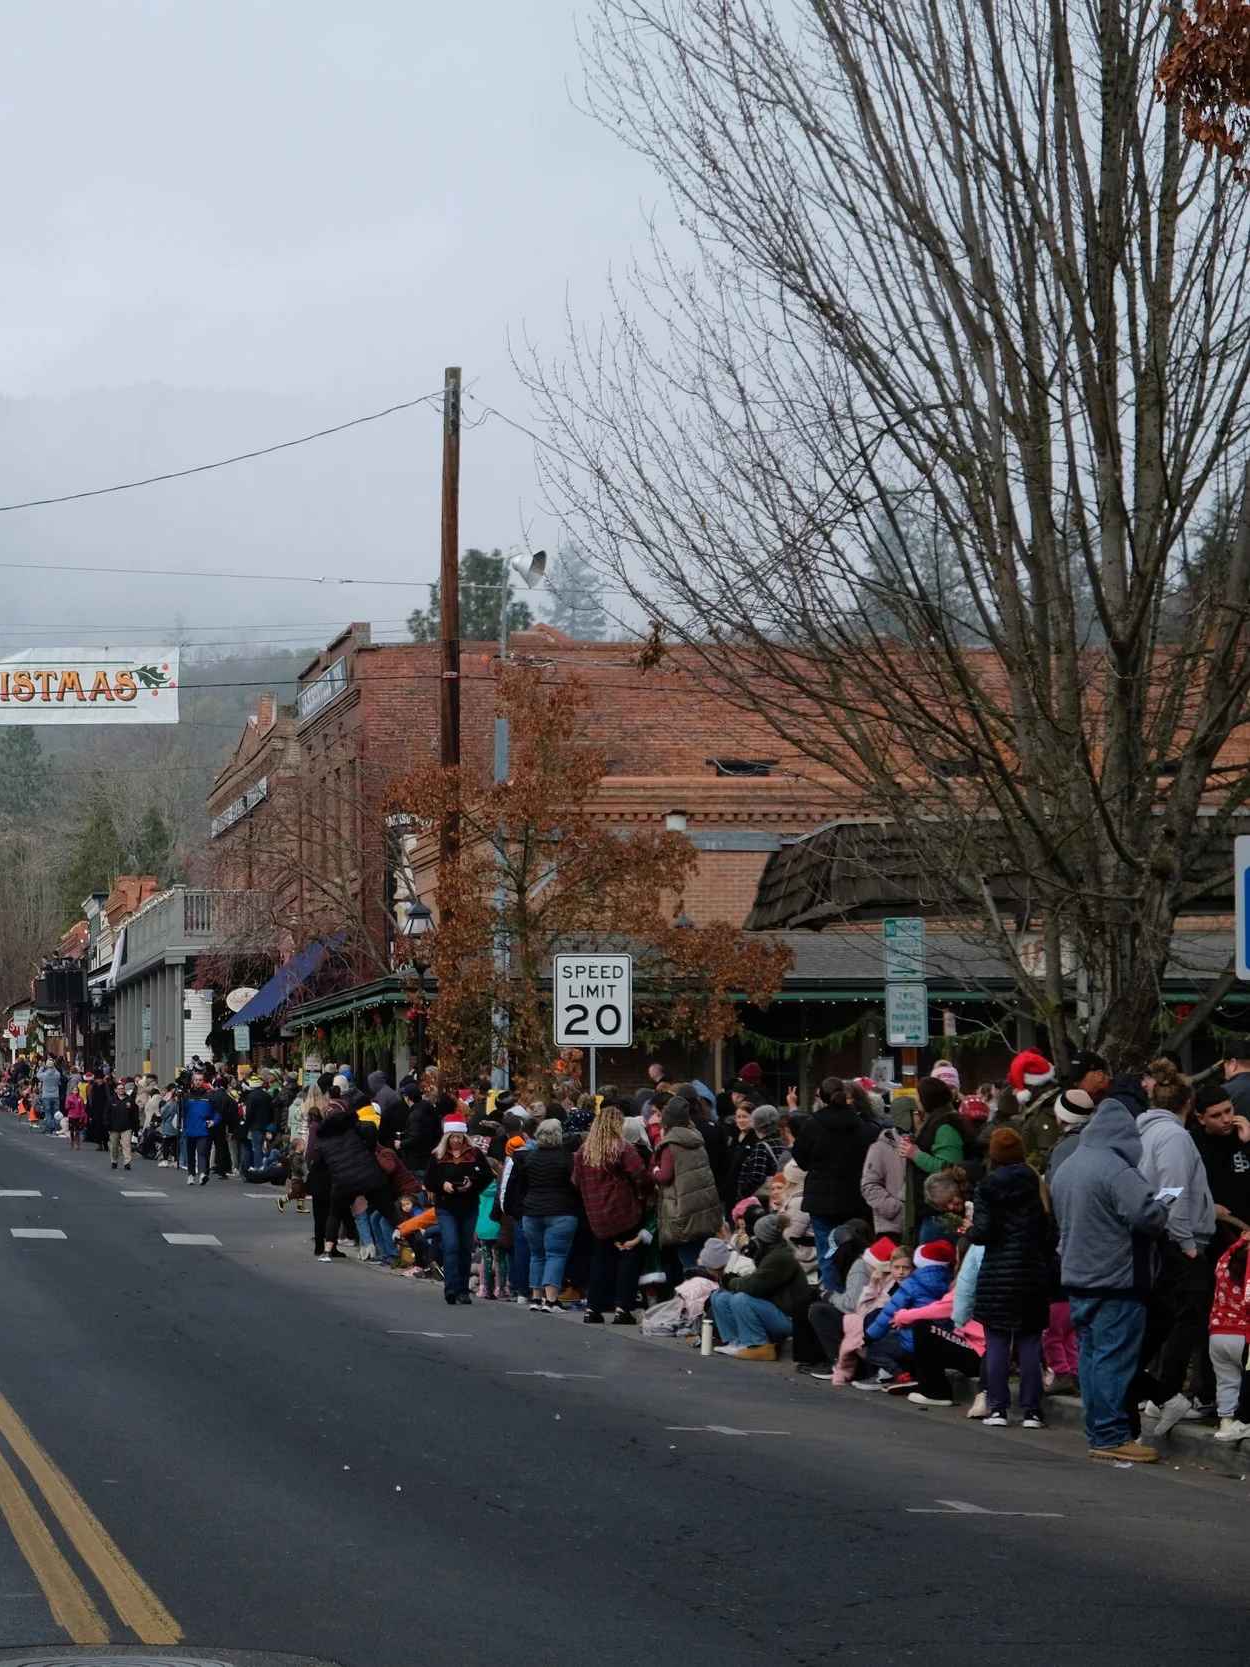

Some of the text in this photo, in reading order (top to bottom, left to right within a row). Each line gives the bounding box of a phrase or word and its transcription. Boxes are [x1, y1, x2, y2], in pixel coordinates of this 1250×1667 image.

[562, 965, 624, 979] SPEED
[569, 985, 617, 998] LIMIT
[896, 1002, 917, 1010] HOUR
[564, 1004, 622, 1035] 20
